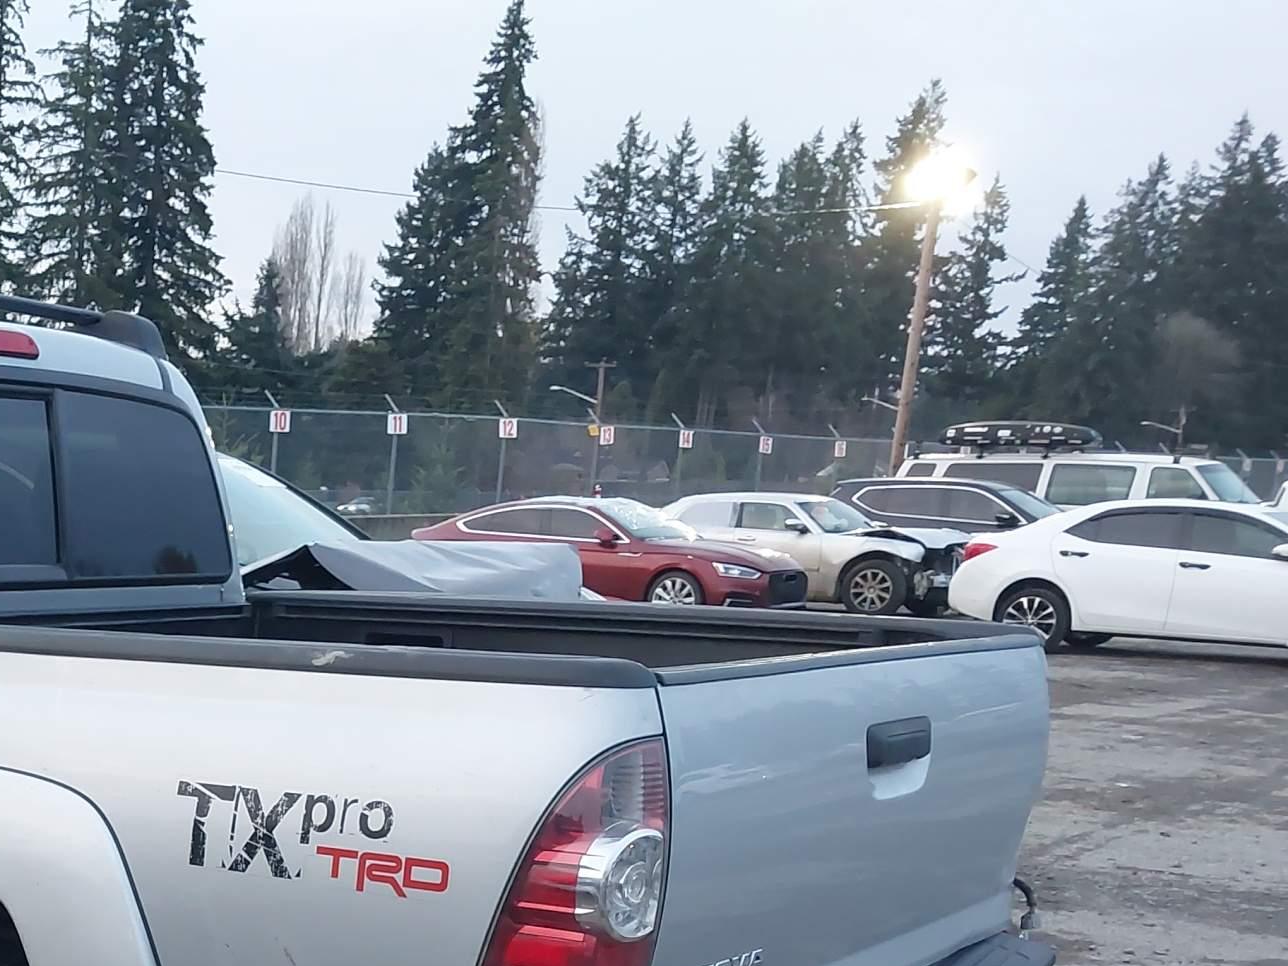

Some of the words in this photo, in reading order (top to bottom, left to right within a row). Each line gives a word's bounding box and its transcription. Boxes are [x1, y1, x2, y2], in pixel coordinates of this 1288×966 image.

[274, 412, 287, 431] 10
[392, 415, 403, 433] 11
[503, 420, 515, 437] 12
[602, 427, 612, 444] 13
[682, 431, 691, 447] 14
[298, 793, 394, 845] pro
[316, 845, 450, 898] TRD
